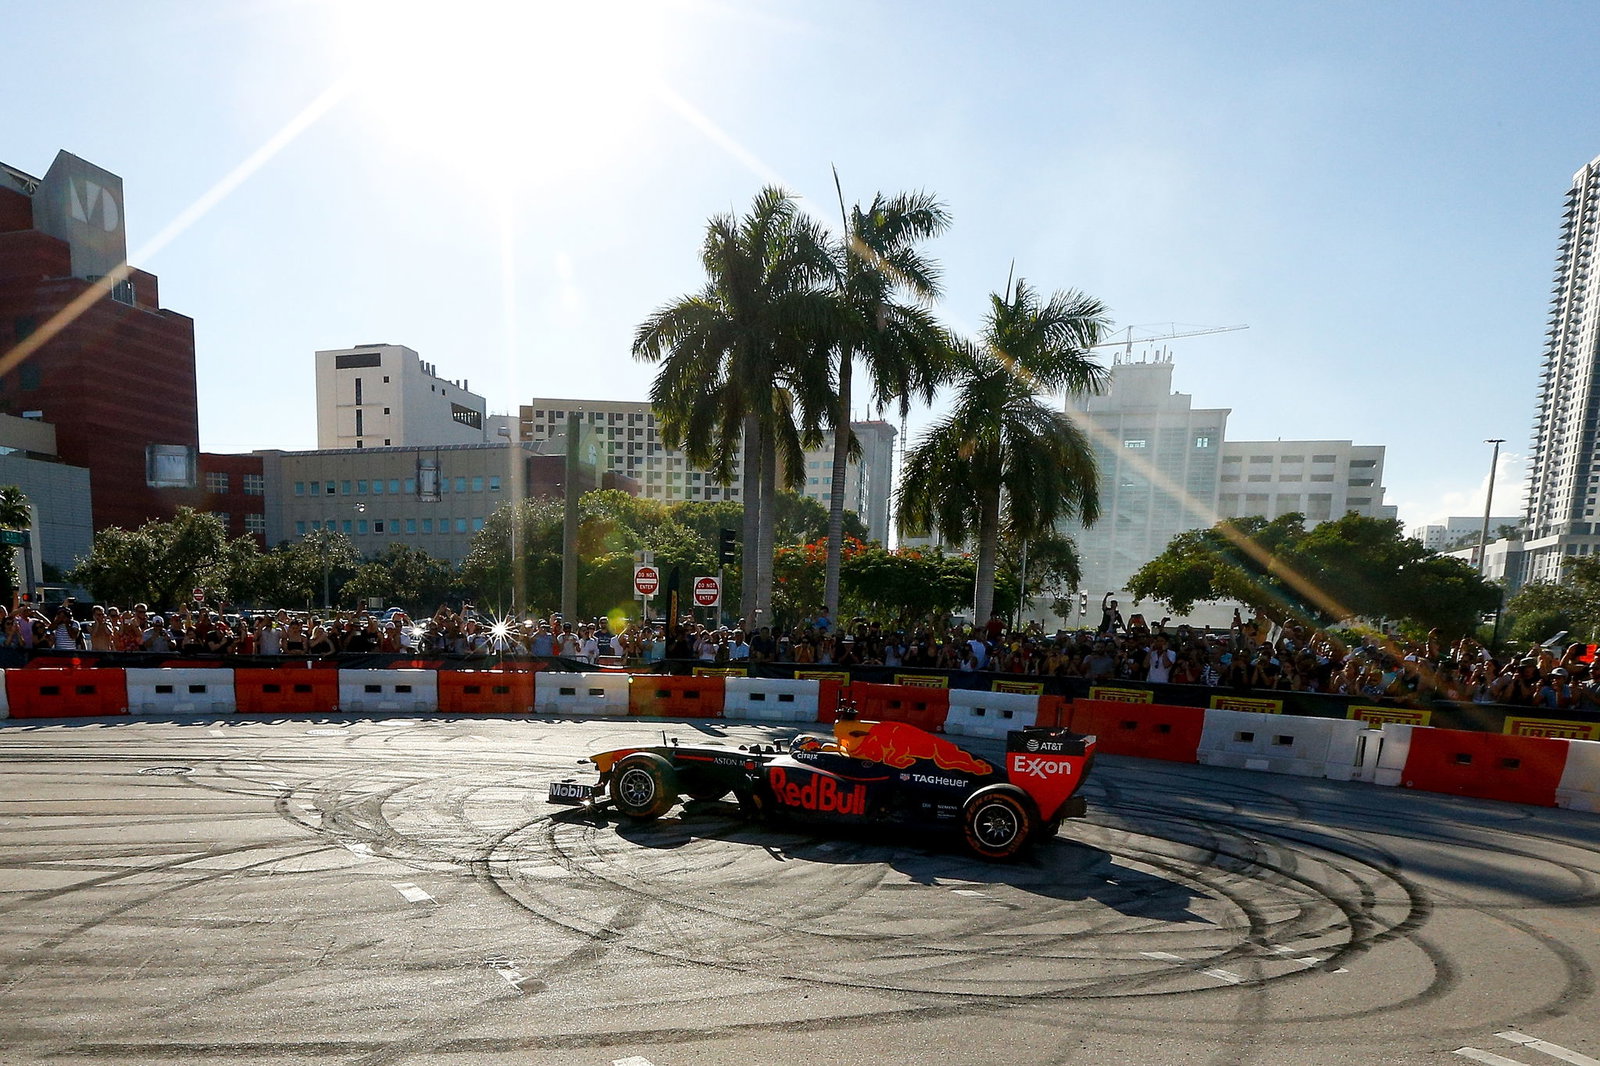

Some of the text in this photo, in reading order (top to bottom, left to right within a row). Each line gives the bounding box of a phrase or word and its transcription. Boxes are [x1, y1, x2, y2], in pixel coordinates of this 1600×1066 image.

[1040, 742, 1063, 751] AT&T
[714, 757, 738, 766] ASTON
[1014, 755, 1071, 779] Exxon
[550, 783, 584, 798] Mobil
